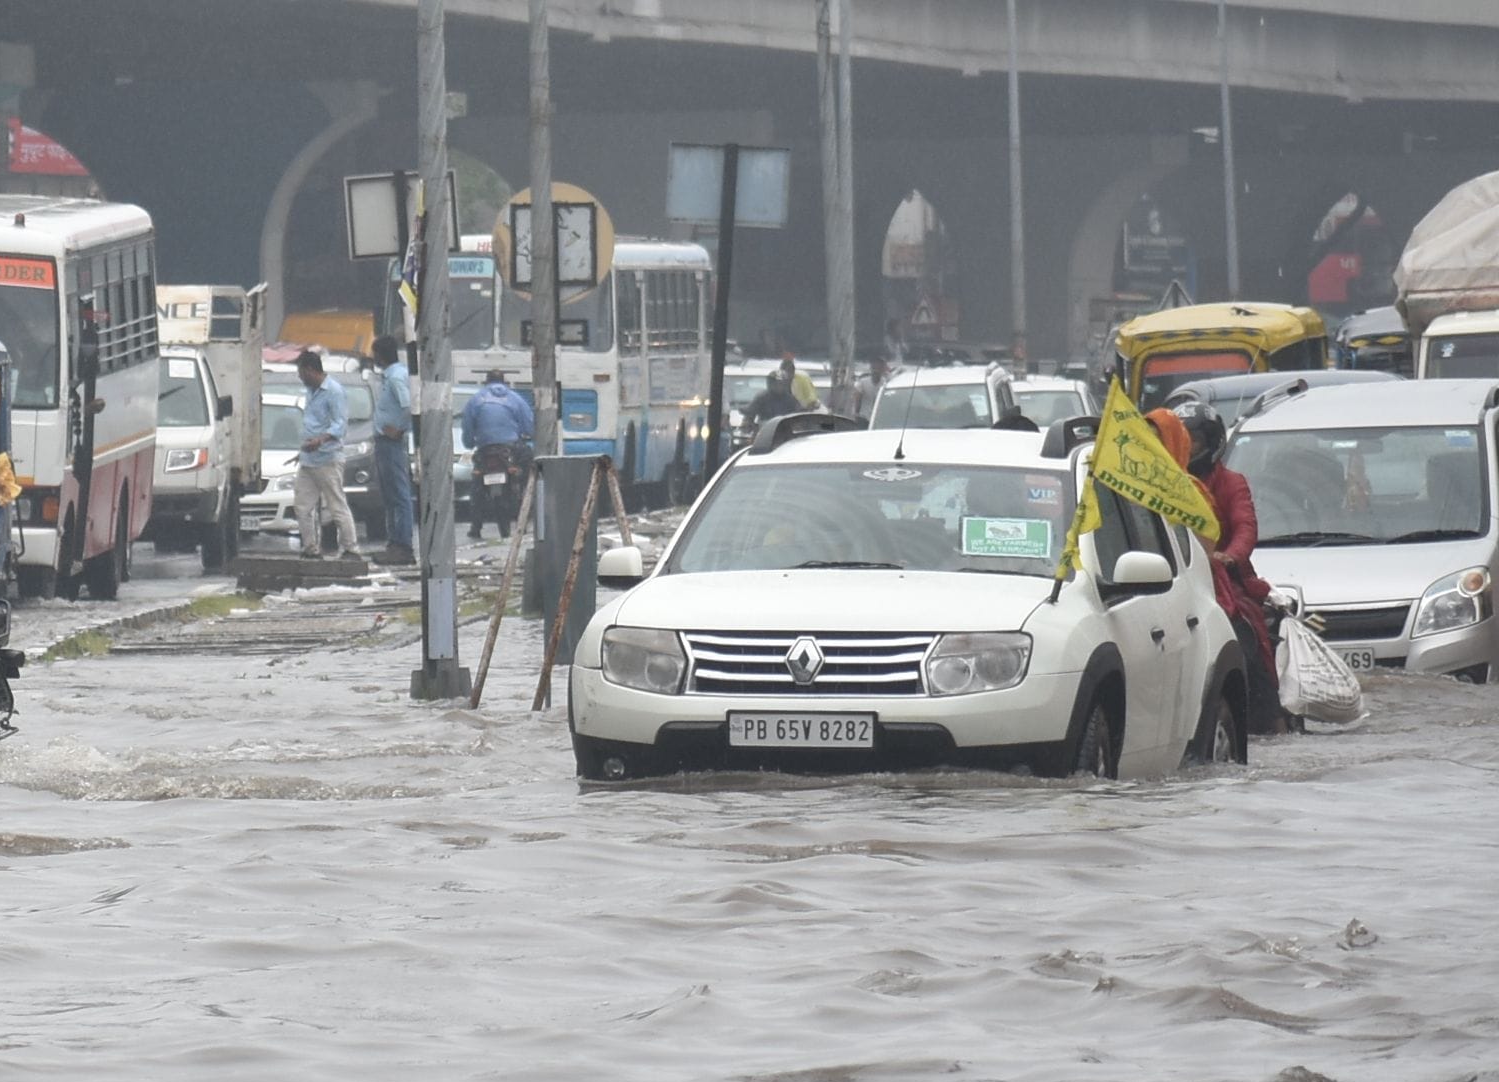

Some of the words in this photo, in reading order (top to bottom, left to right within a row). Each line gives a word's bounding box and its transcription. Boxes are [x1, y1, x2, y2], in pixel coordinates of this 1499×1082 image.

[1029, 488, 1057, 500] VIP
[743, 719, 768, 740] PB
[776, 720, 811, 741] 65V
[819, 721, 869, 741] 8282
